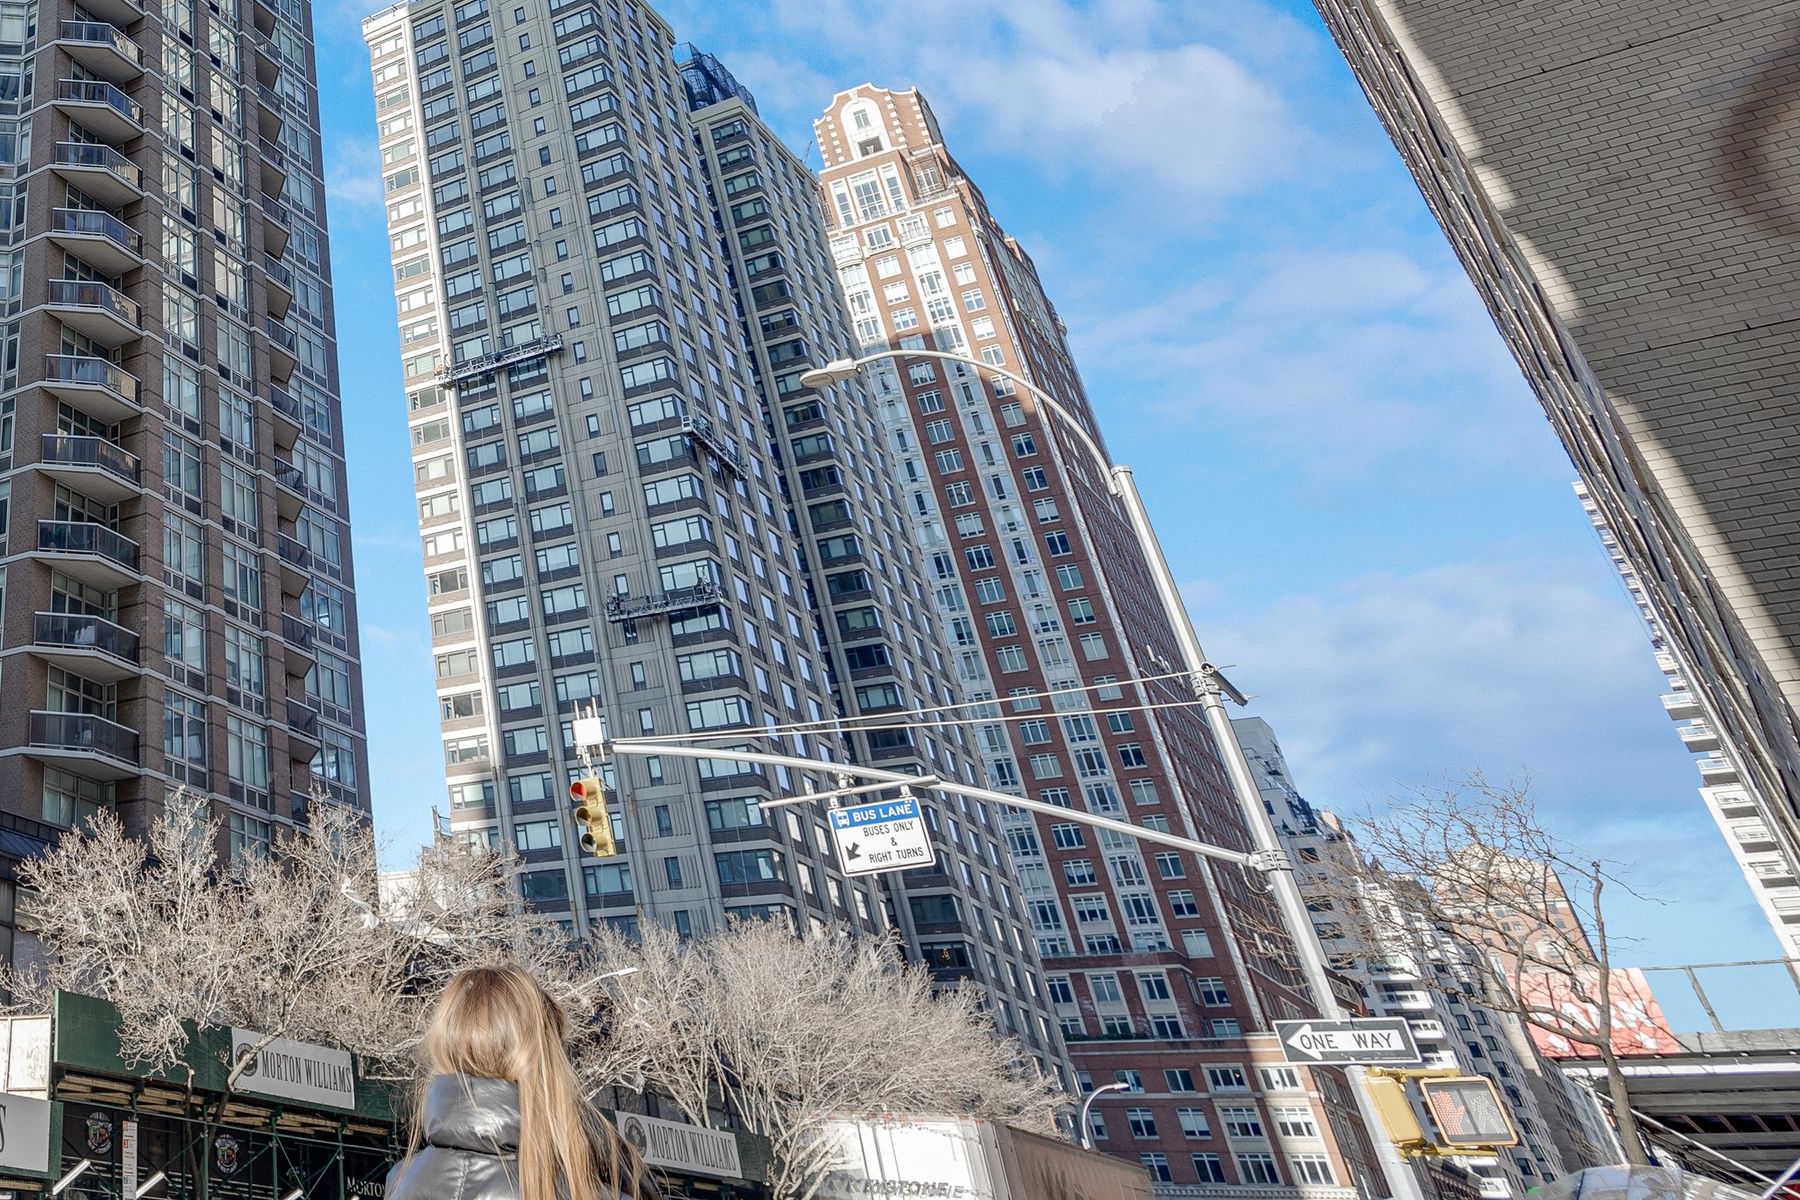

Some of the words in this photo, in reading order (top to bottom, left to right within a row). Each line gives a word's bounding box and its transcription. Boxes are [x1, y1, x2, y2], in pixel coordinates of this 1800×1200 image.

[852, 809, 878, 823] BUS
[879, 804, 912, 819] LANE
[863, 824, 890, 838] BUSES
[893, 820, 914, 833] ONLY
[890, 836, 898, 846] &
[869, 851, 893, 864] RIGHT
[896, 847, 924, 860] TURNS
[1299, 1033, 1338, 1050] ONE
[1352, 1032, 1391, 1049] WAY
[261, 1049, 302, 1084] MORTON
[304, 1058, 352, 1093] WILLIAMS
[647, 1123, 690, 1164] MORTON
[688, 1131, 737, 1171] WILLIAMS
